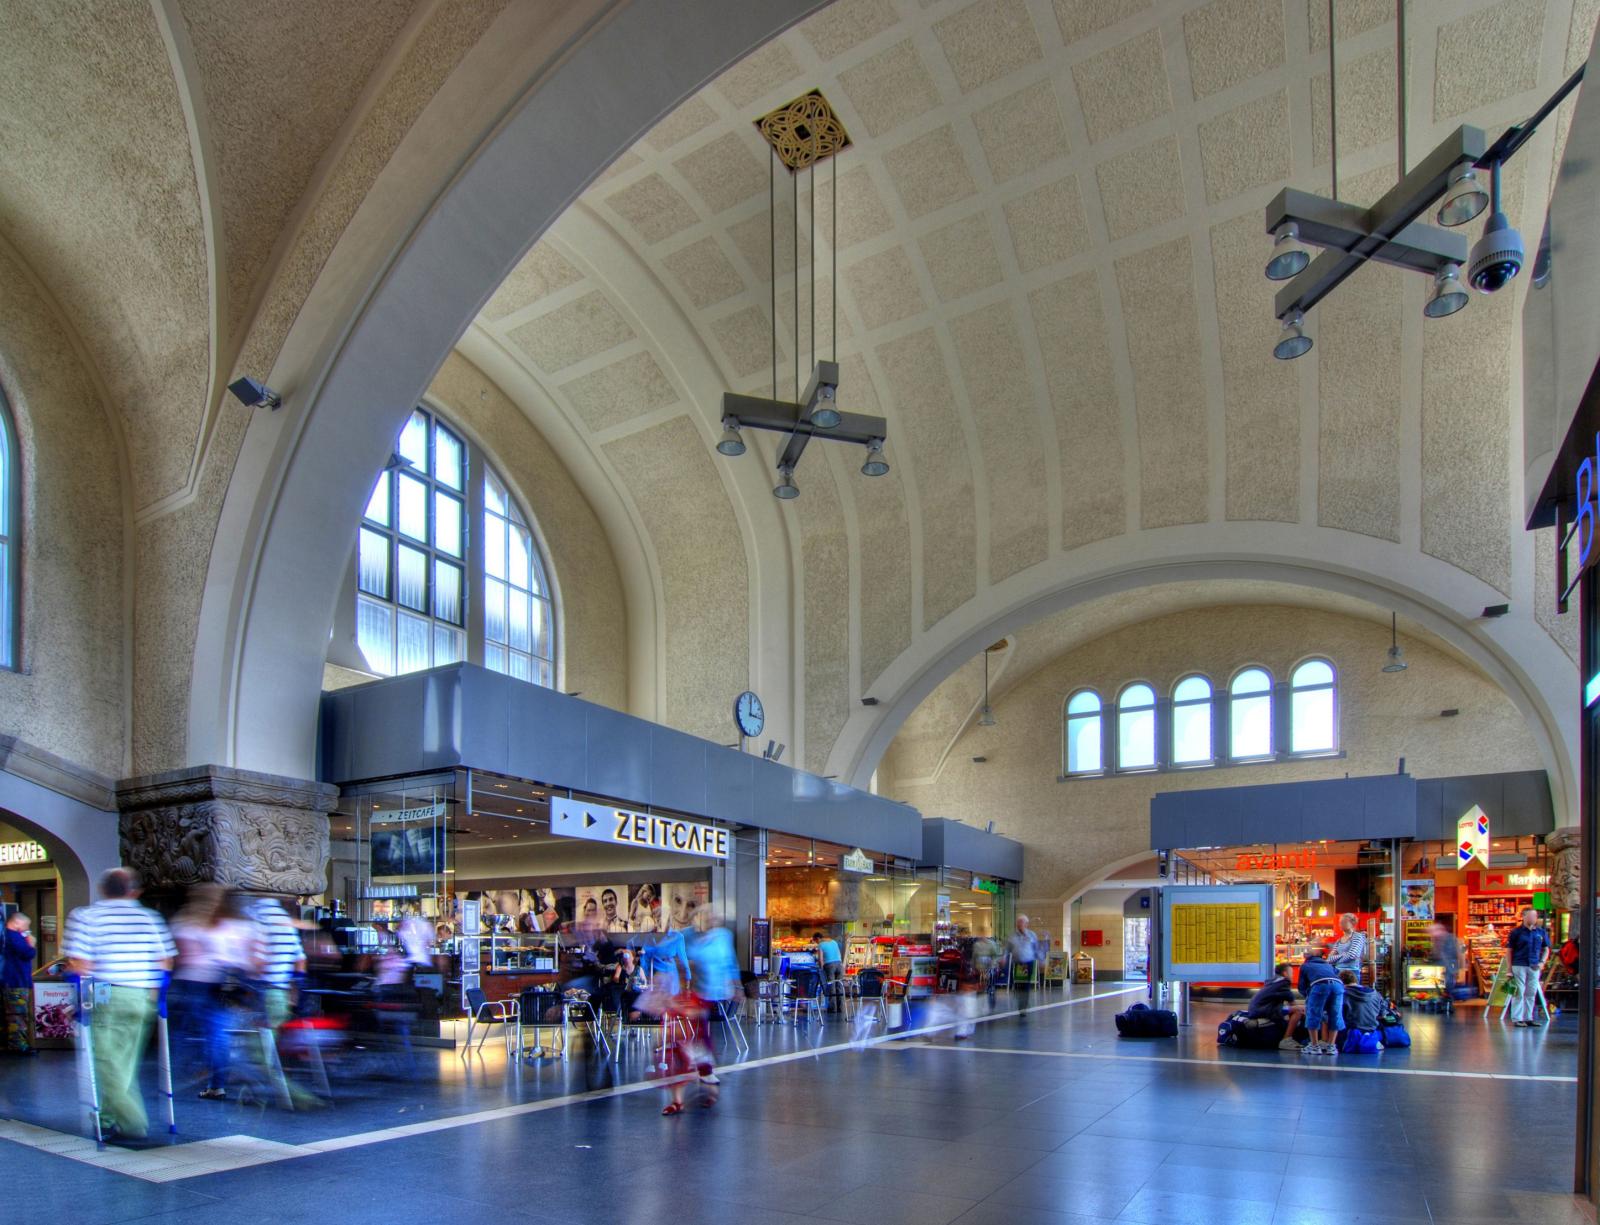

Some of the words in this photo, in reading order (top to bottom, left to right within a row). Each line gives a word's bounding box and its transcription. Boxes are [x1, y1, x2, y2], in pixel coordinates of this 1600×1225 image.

[398, 807, 435, 820] ZEITCAFE
[614, 809, 726, 855] ZEITCAFE
[0, 841, 42, 861] EITCAFE
[1235, 848, 1317, 871] avanti
[1508, 874, 1552, 885] Marlbor
